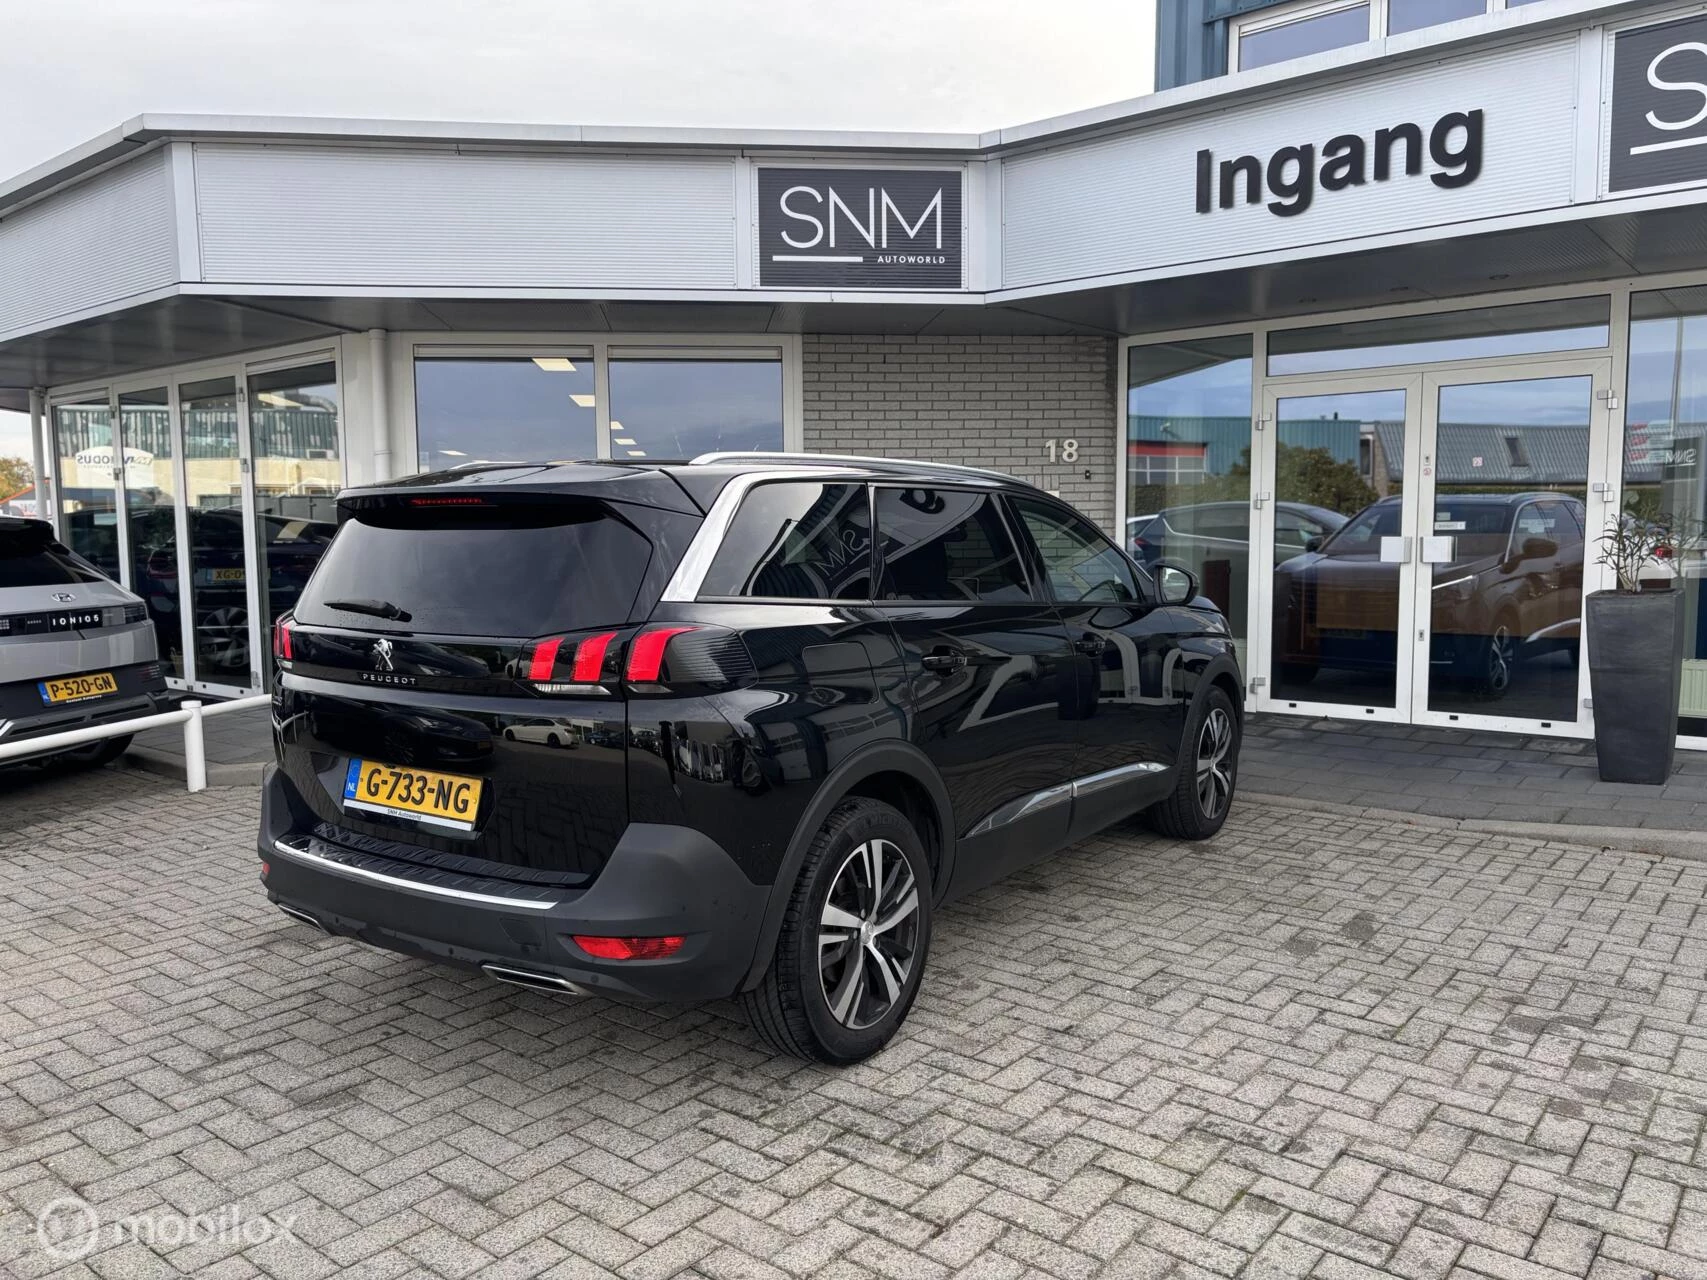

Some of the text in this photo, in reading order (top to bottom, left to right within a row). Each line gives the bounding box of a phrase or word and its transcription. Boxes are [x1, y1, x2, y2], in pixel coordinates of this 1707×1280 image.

[1196, 109, 1484, 217] Ingang
[780, 185, 942, 249] SNM
[877, 255, 946, 264] AUTOWORLD
[1045, 439, 1079, 463] 18
[50, 677, 112, 698] P-520-GN
[362, 673, 416, 685] PEUGEOT
[347, 782, 356, 793] NL
[366, 768, 471, 813] G-733-NG
